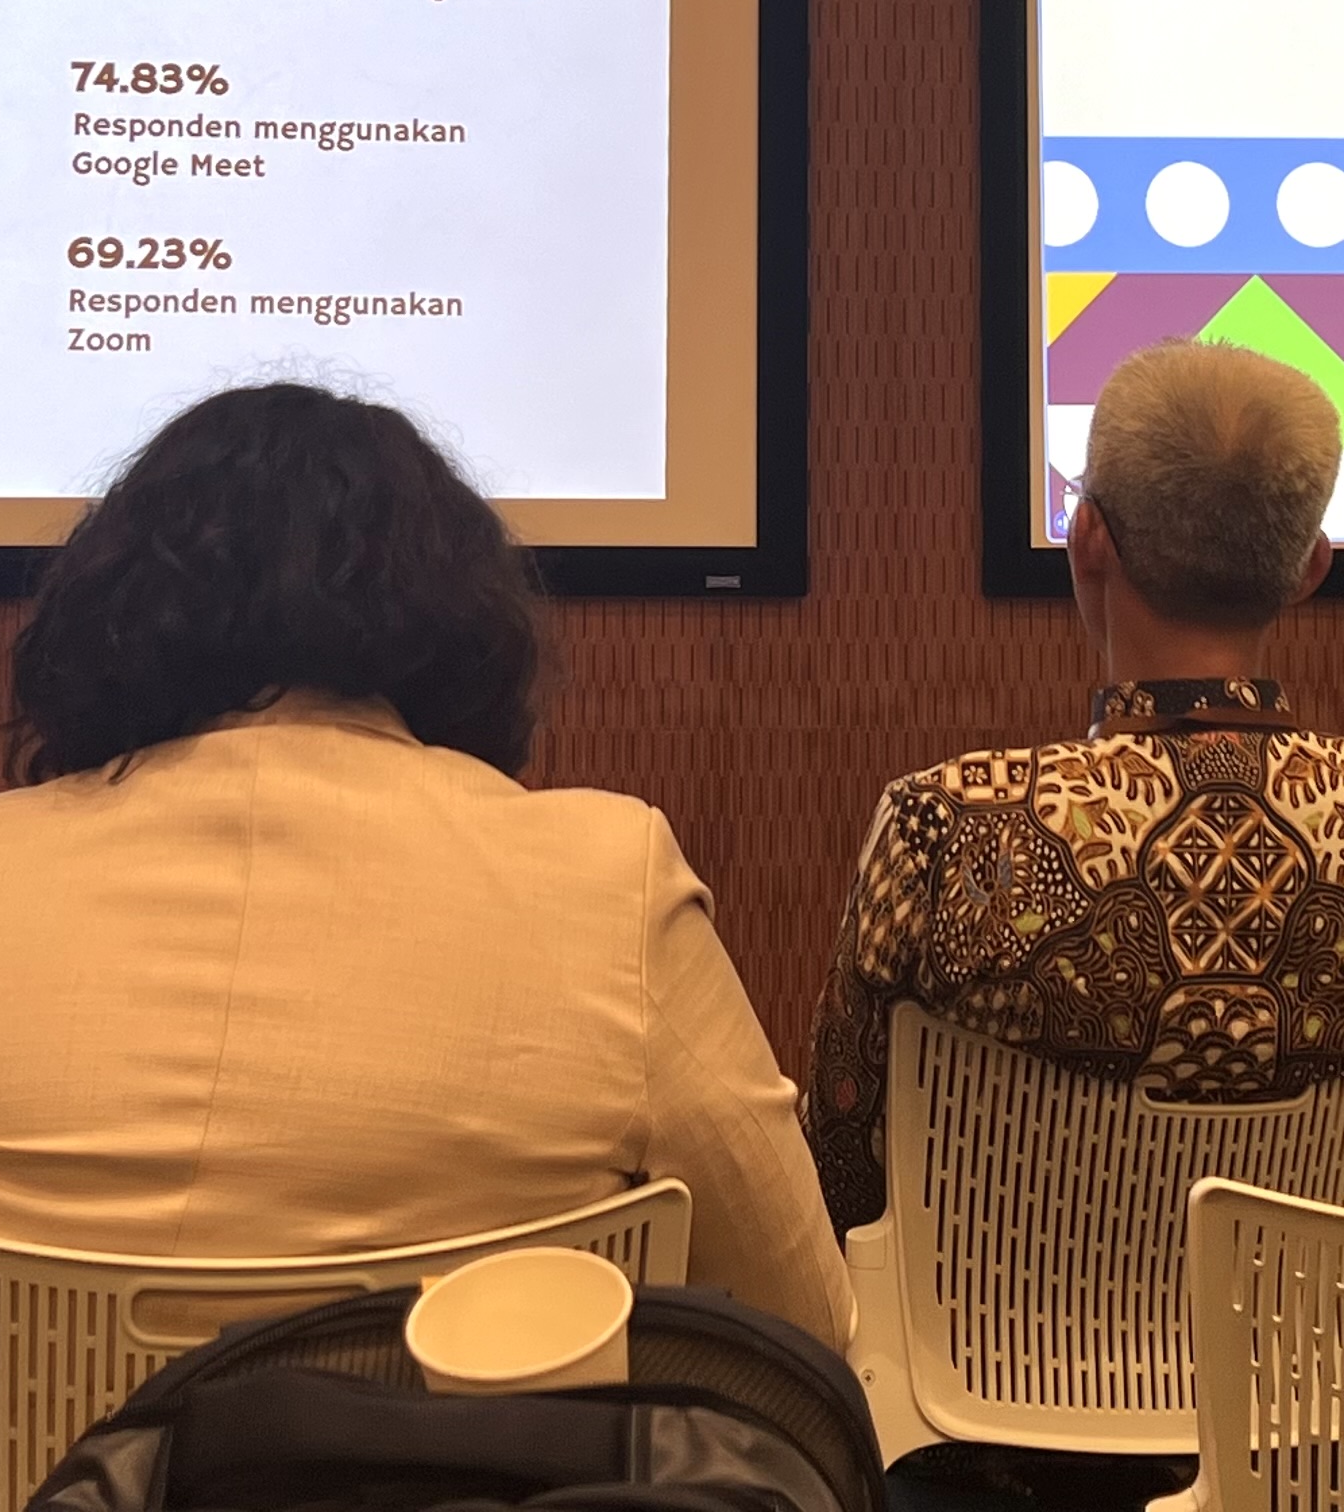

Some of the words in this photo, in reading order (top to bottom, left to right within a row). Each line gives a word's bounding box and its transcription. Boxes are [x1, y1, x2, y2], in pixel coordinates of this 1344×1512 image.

[71, 62, 228, 95] 74.83%
[75, 113, 240, 142] Responden
[255, 119, 464, 151] menggunakan
[73, 151, 177, 186] Google
[192, 154, 265, 177] Meet
[68, 237, 232, 270] 69.23%
[70, 288, 236, 318] Responden
[251, 292, 462, 325] menggunakan
[68, 329, 150, 351] Zoom
